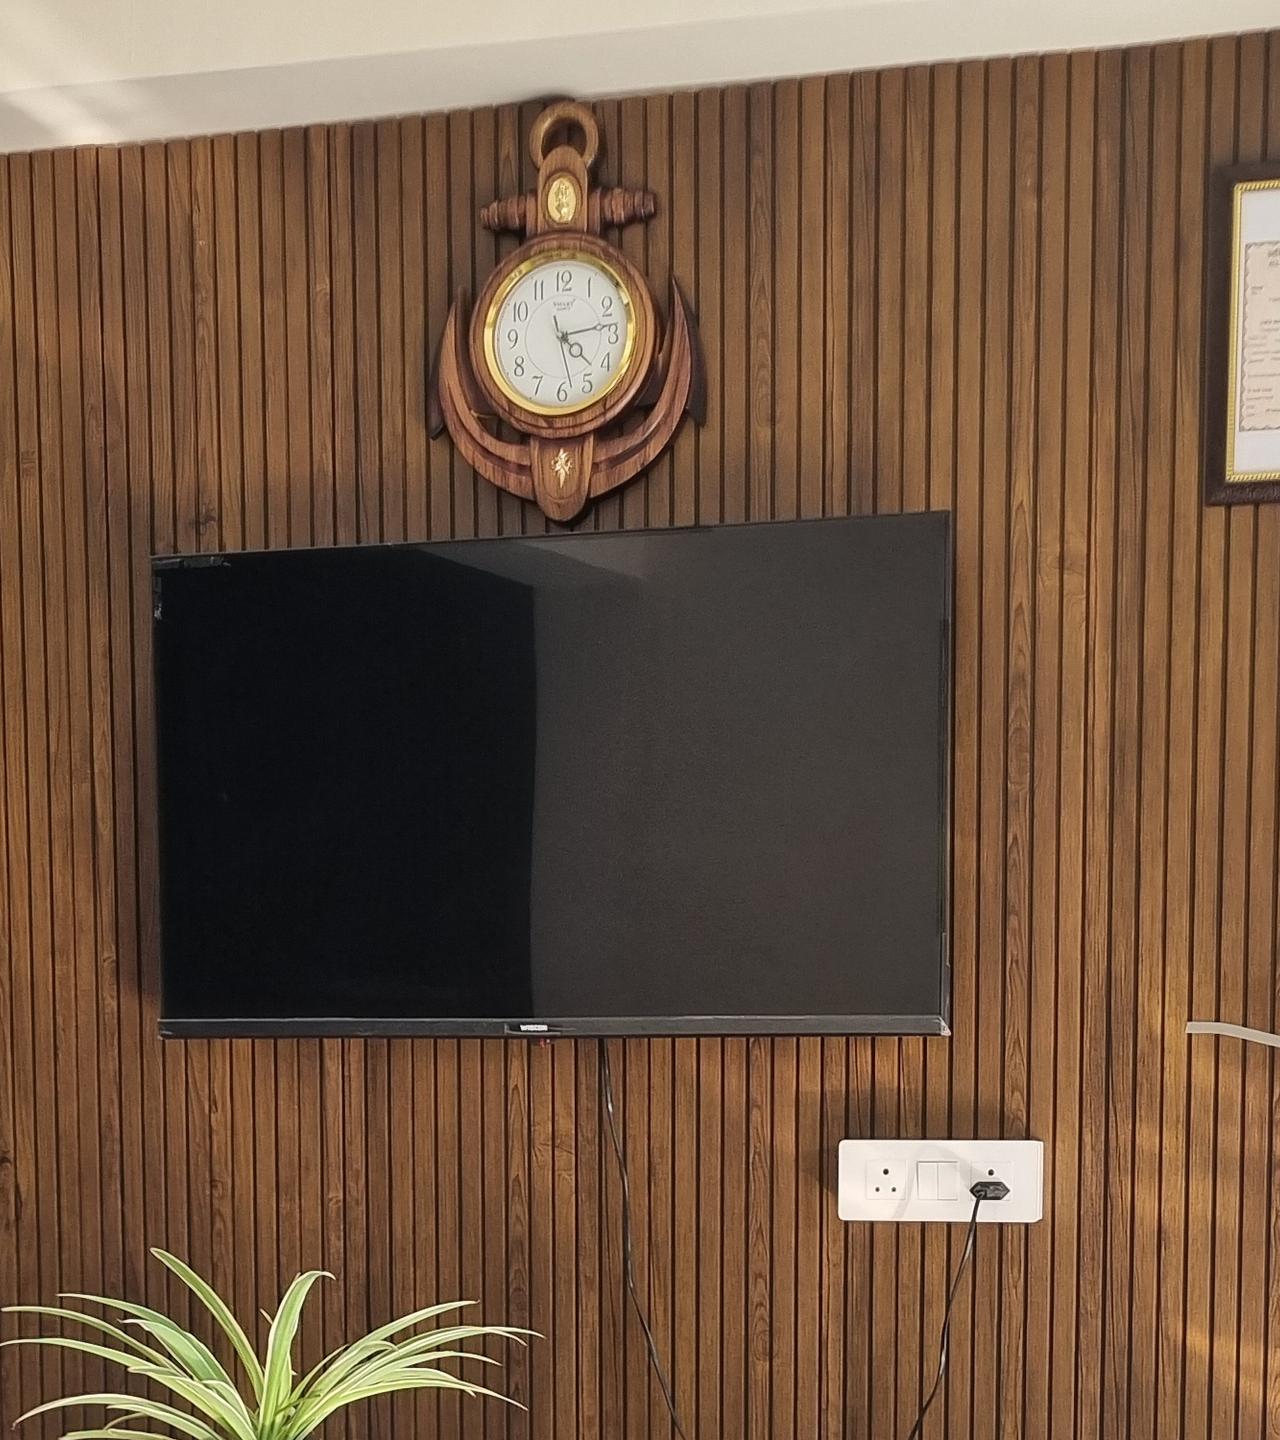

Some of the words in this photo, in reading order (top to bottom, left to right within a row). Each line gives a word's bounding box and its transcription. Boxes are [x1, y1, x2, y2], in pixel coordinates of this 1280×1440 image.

[534, 279, 544, 301] 11
[556, 270, 572, 292] 12
[513, 301, 528, 323] 10
[601, 296, 613, 317] 2
[507, 329, 518, 349] 9
[608, 323, 619, 344] 3
[514, 356, 524, 377] 8
[600, 352, 610, 372] 4
[532, 376, 543, 396] 7
[557, 381, 567, 402] 6
[582, 373, 593, 394] 5
